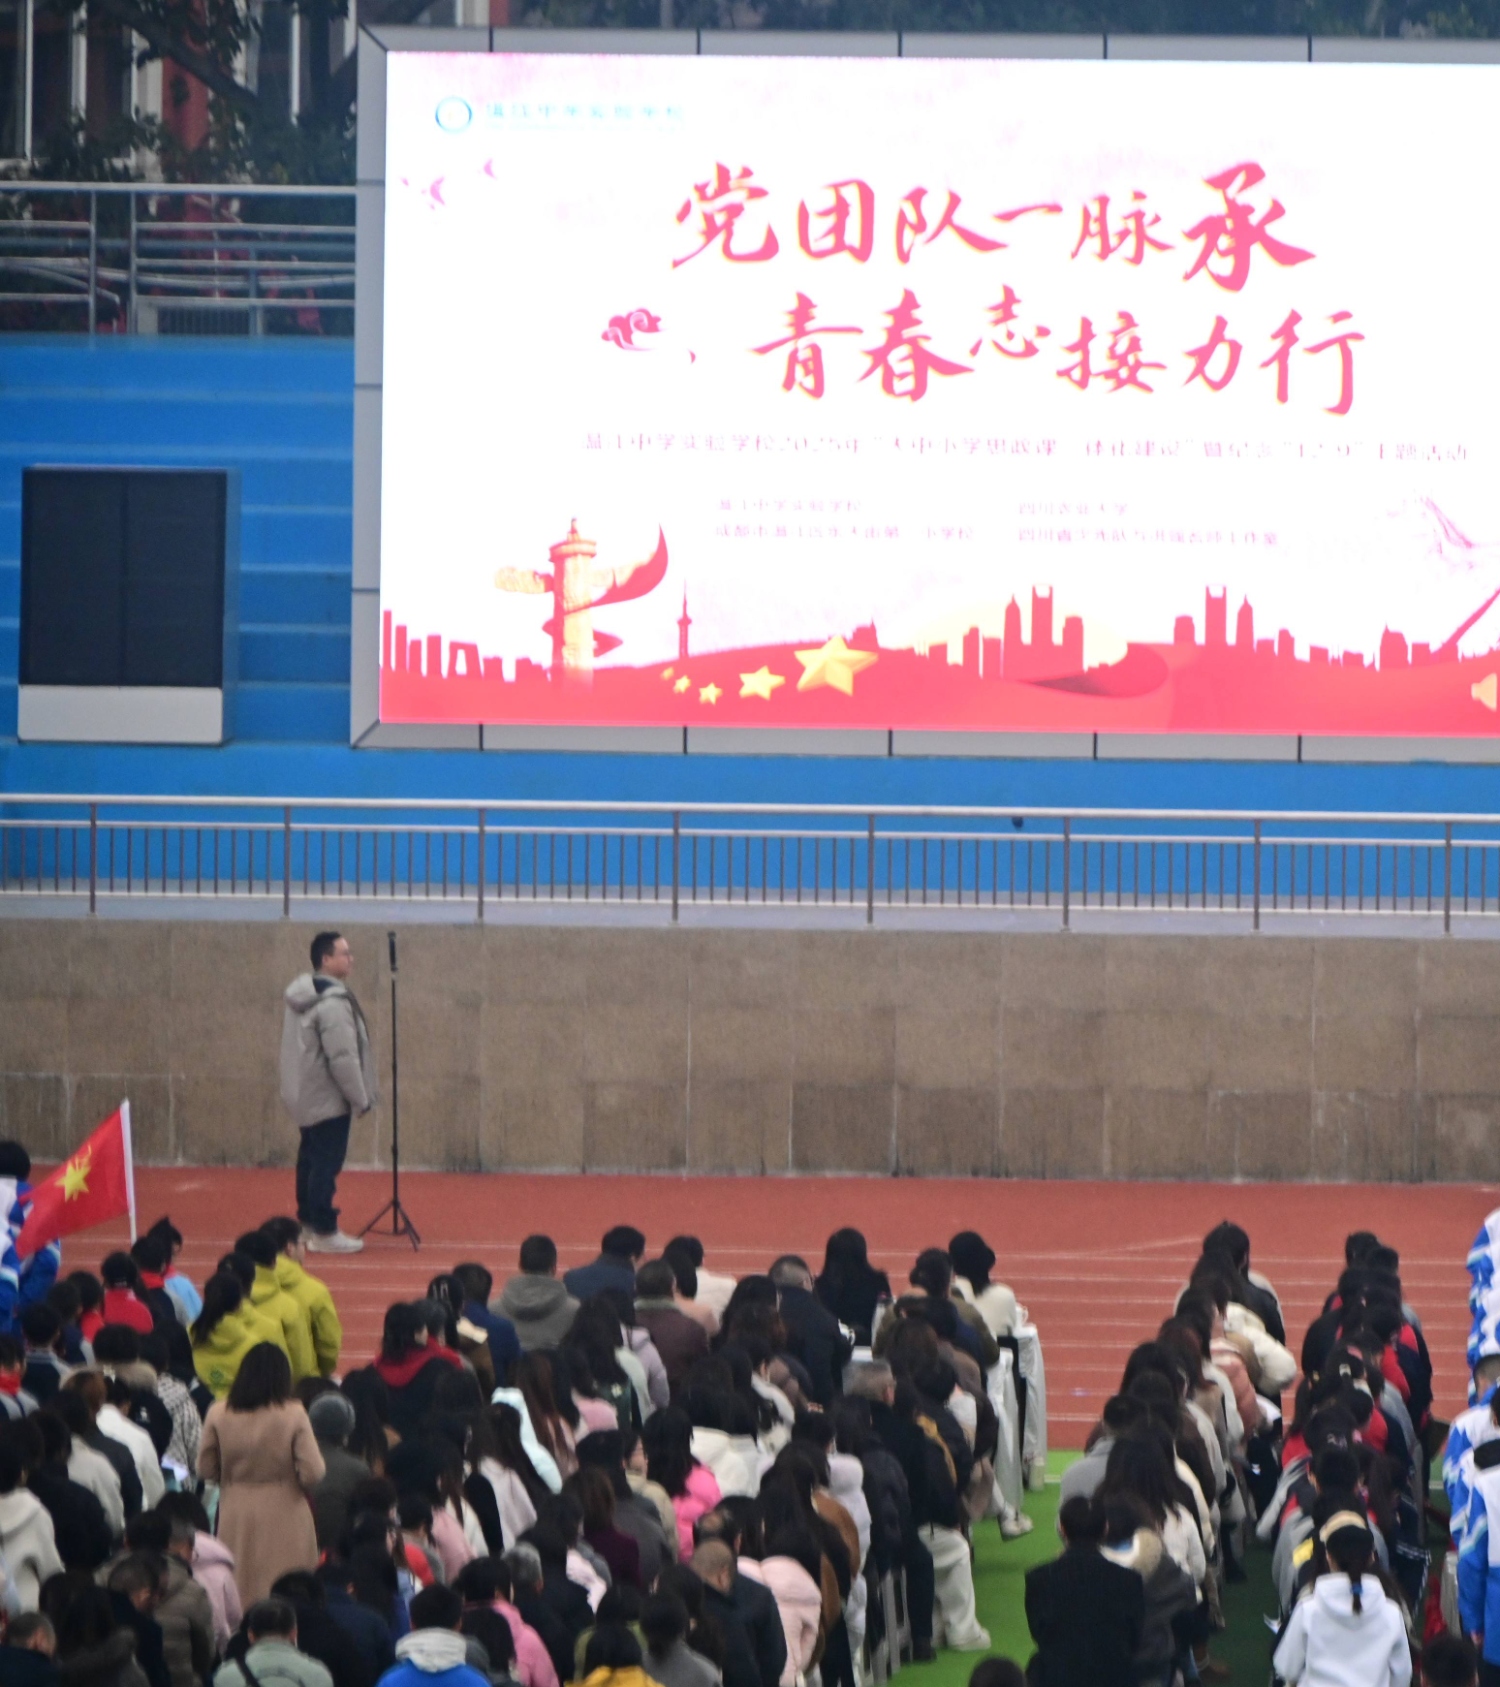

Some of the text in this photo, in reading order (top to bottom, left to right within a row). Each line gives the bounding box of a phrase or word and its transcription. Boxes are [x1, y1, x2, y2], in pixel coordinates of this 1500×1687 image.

[672, 161, 1316, 292] 党团队一脉承
[753, 284, 1365, 415] 青春志接力行
